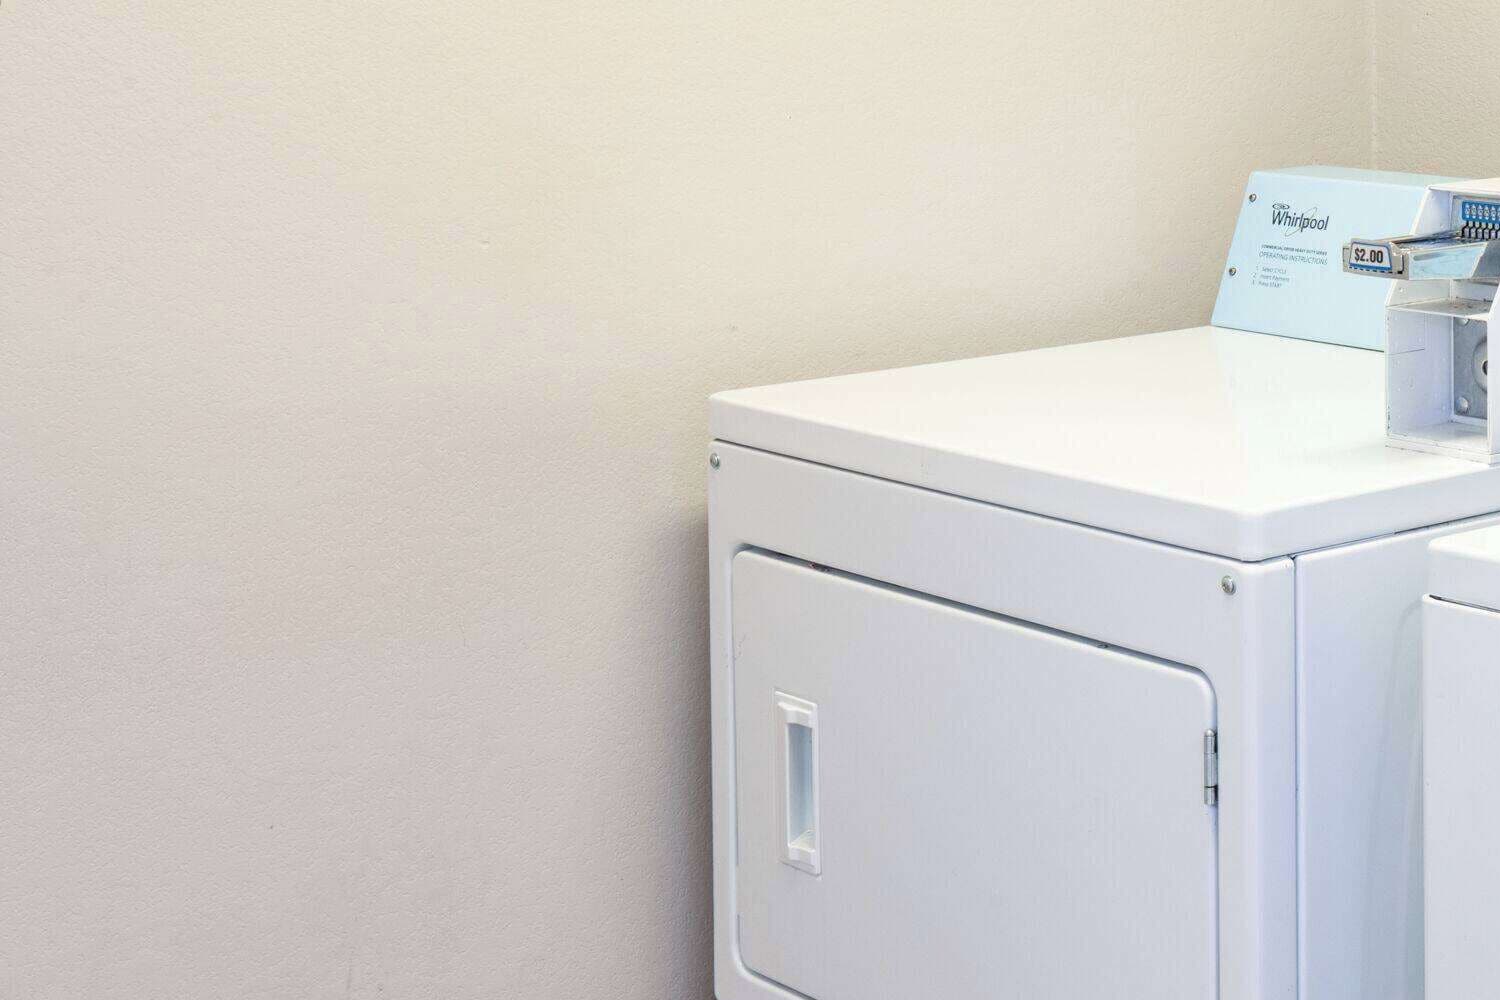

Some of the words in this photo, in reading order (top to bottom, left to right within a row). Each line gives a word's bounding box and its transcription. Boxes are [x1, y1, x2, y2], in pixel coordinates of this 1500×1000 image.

[1272, 209, 1329, 233] Whirlpool
[1259, 251, 1288, 261] OPERATING
[1289, 254, 1328, 265] INSTRUCTIONS
[1354, 247, 1384, 264] $2.00
